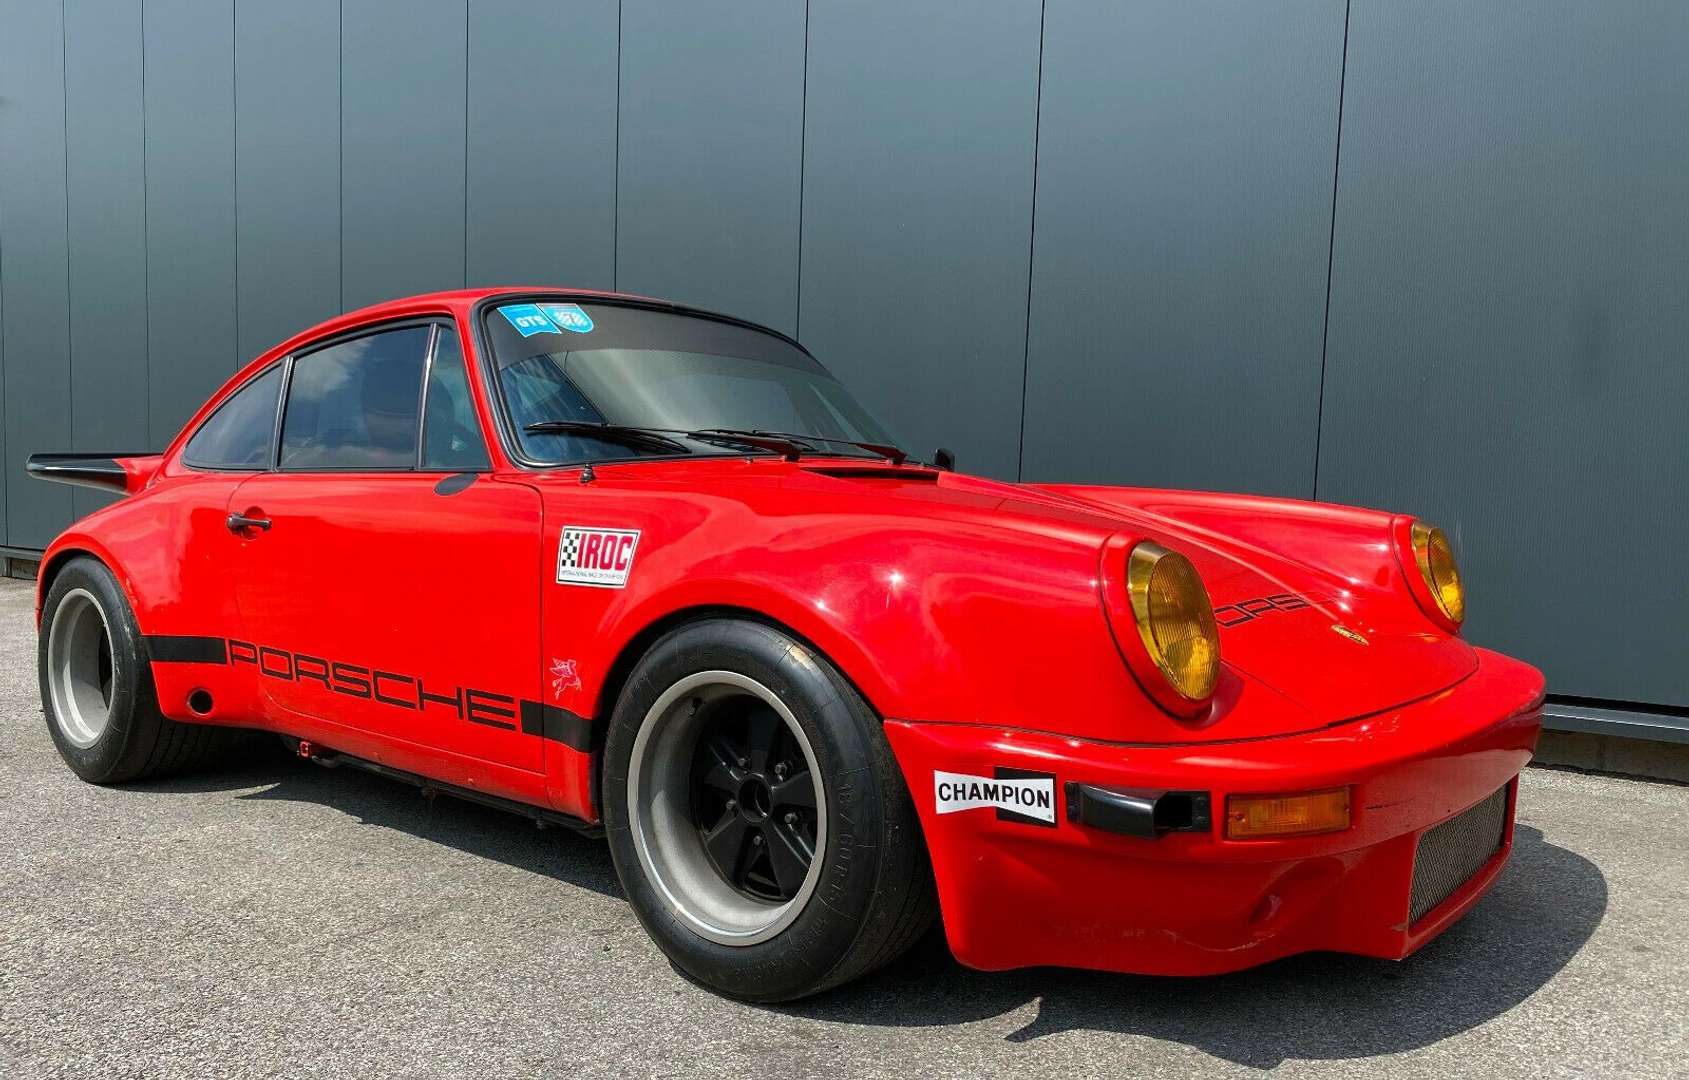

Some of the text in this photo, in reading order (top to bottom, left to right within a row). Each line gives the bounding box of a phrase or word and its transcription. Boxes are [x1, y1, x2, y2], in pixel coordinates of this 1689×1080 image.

[515, 315, 548, 328] GTS
[576, 533, 634, 571] IROC
[229, 638, 517, 732] PORSCHE
[938, 779, 1050, 809] CHAMPION
